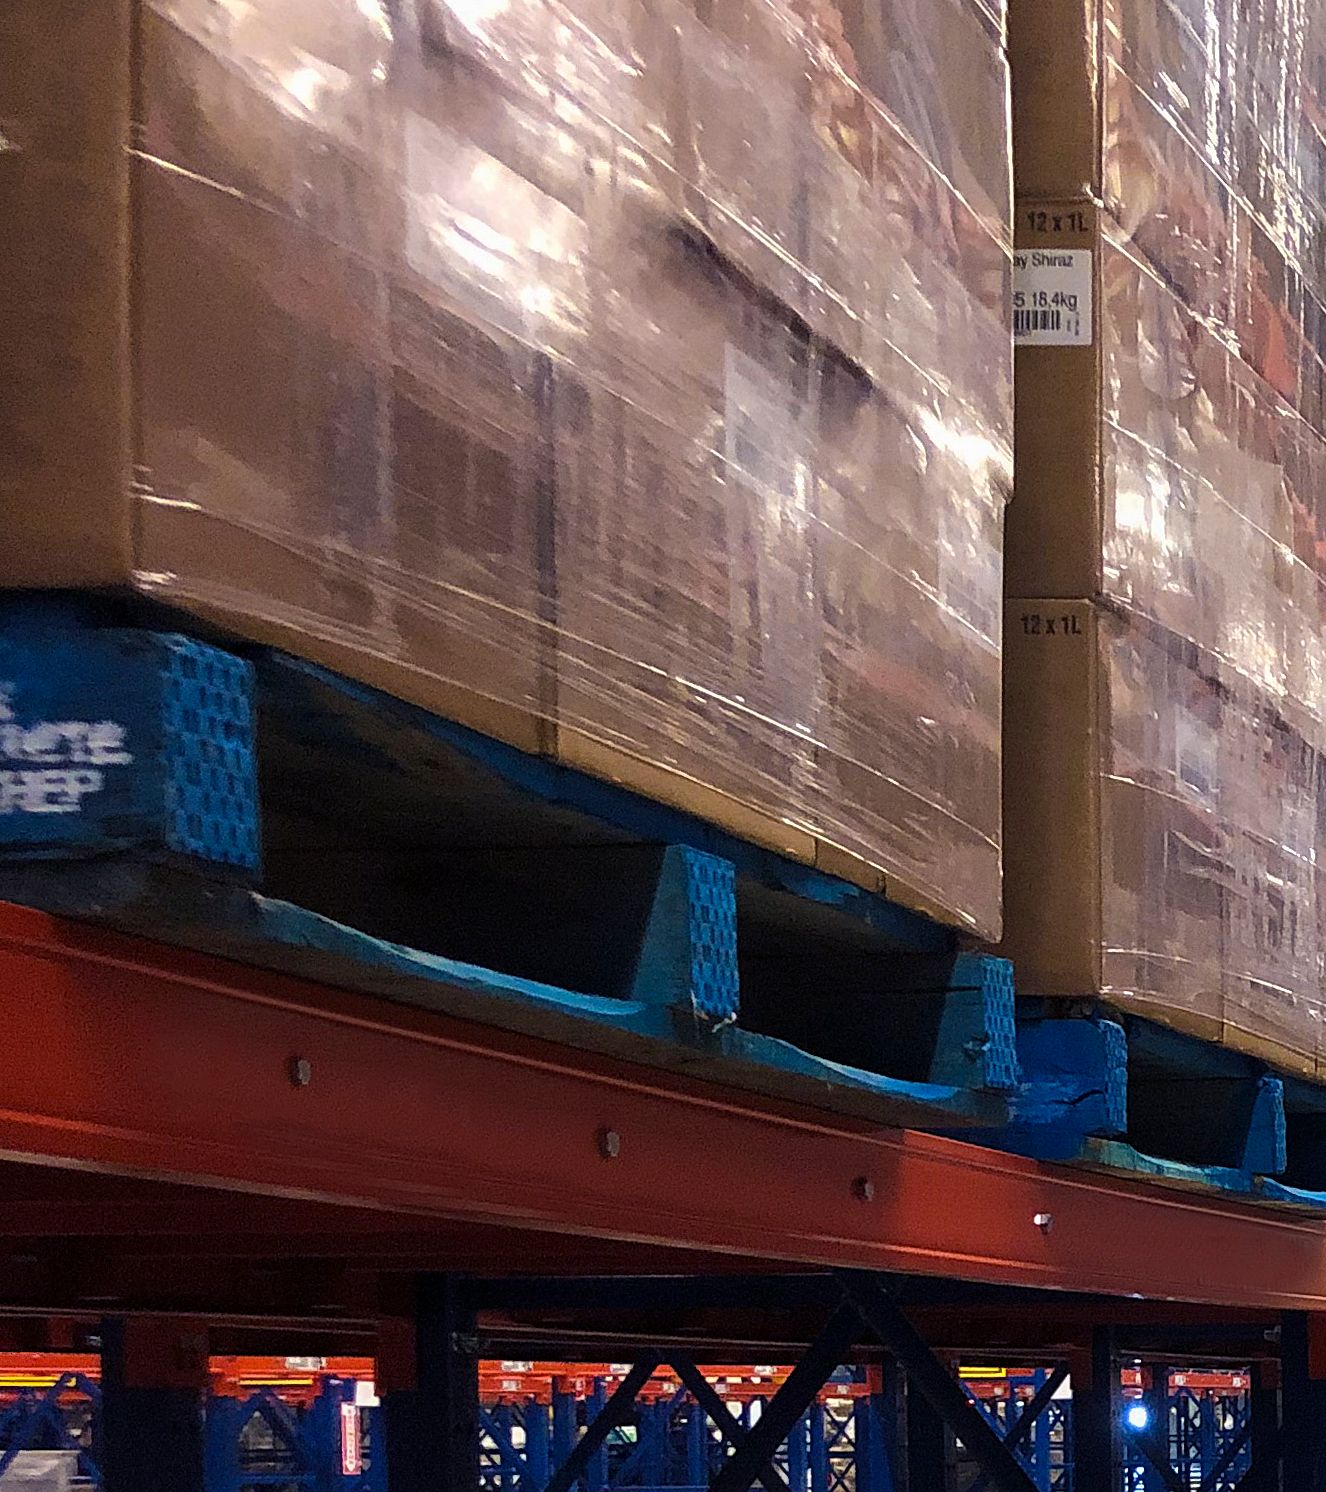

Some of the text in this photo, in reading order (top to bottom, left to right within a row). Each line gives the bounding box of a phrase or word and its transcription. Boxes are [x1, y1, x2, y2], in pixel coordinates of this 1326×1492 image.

[1027, 211, 1089, 232] 12 x 1L
[1032, 252, 1074, 267] Shiraz
[1020, 613, 1082, 635] 12 x 1L
